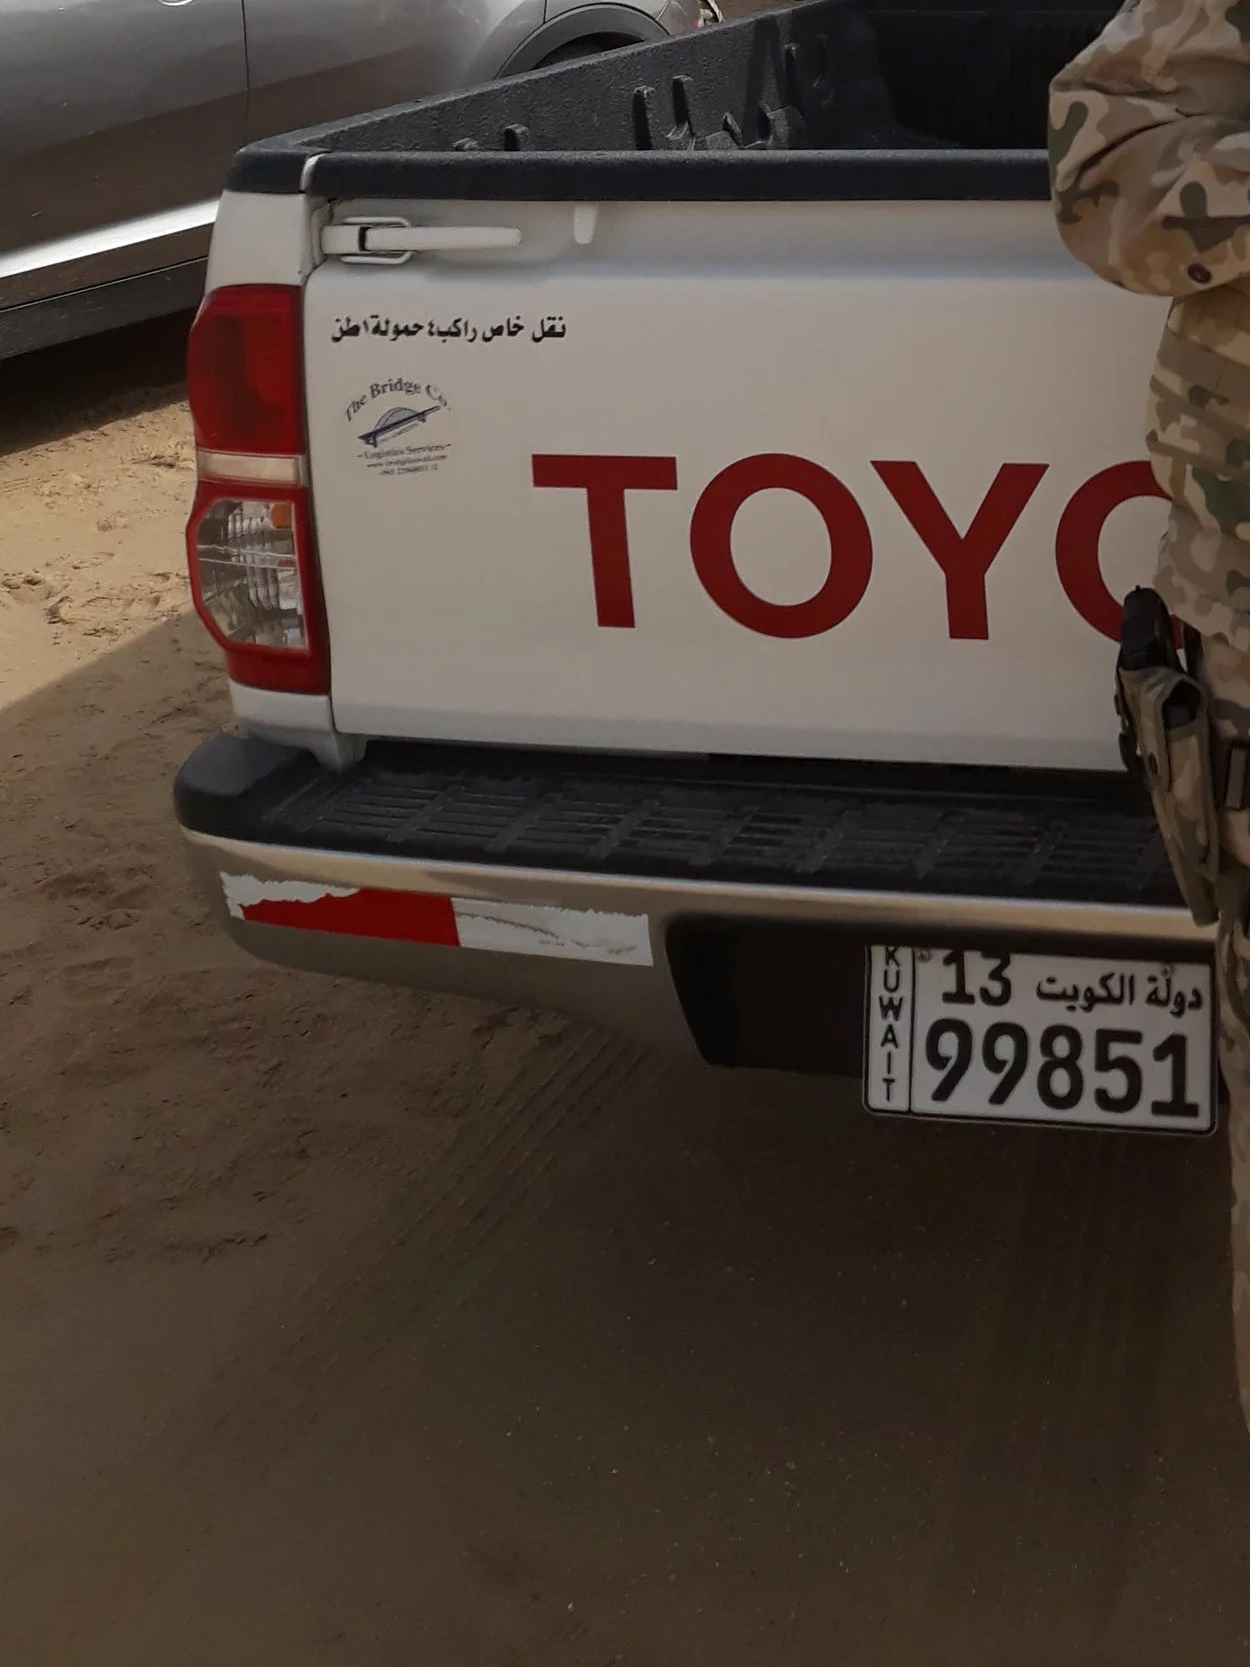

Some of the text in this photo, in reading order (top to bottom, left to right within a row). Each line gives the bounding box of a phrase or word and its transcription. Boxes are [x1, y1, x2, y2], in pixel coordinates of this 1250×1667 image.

[481, 315, 525, 342] خاص
[531, 316, 567, 343] نقل
[369, 377, 421, 399] Bridge
[942, 949, 1012, 1007] 13
[1036, 972, 1203, 1018] دولة الكويت
[879, 946, 904, 1102] KUWAIT
[925, 1018, 1200, 1118] 99851
